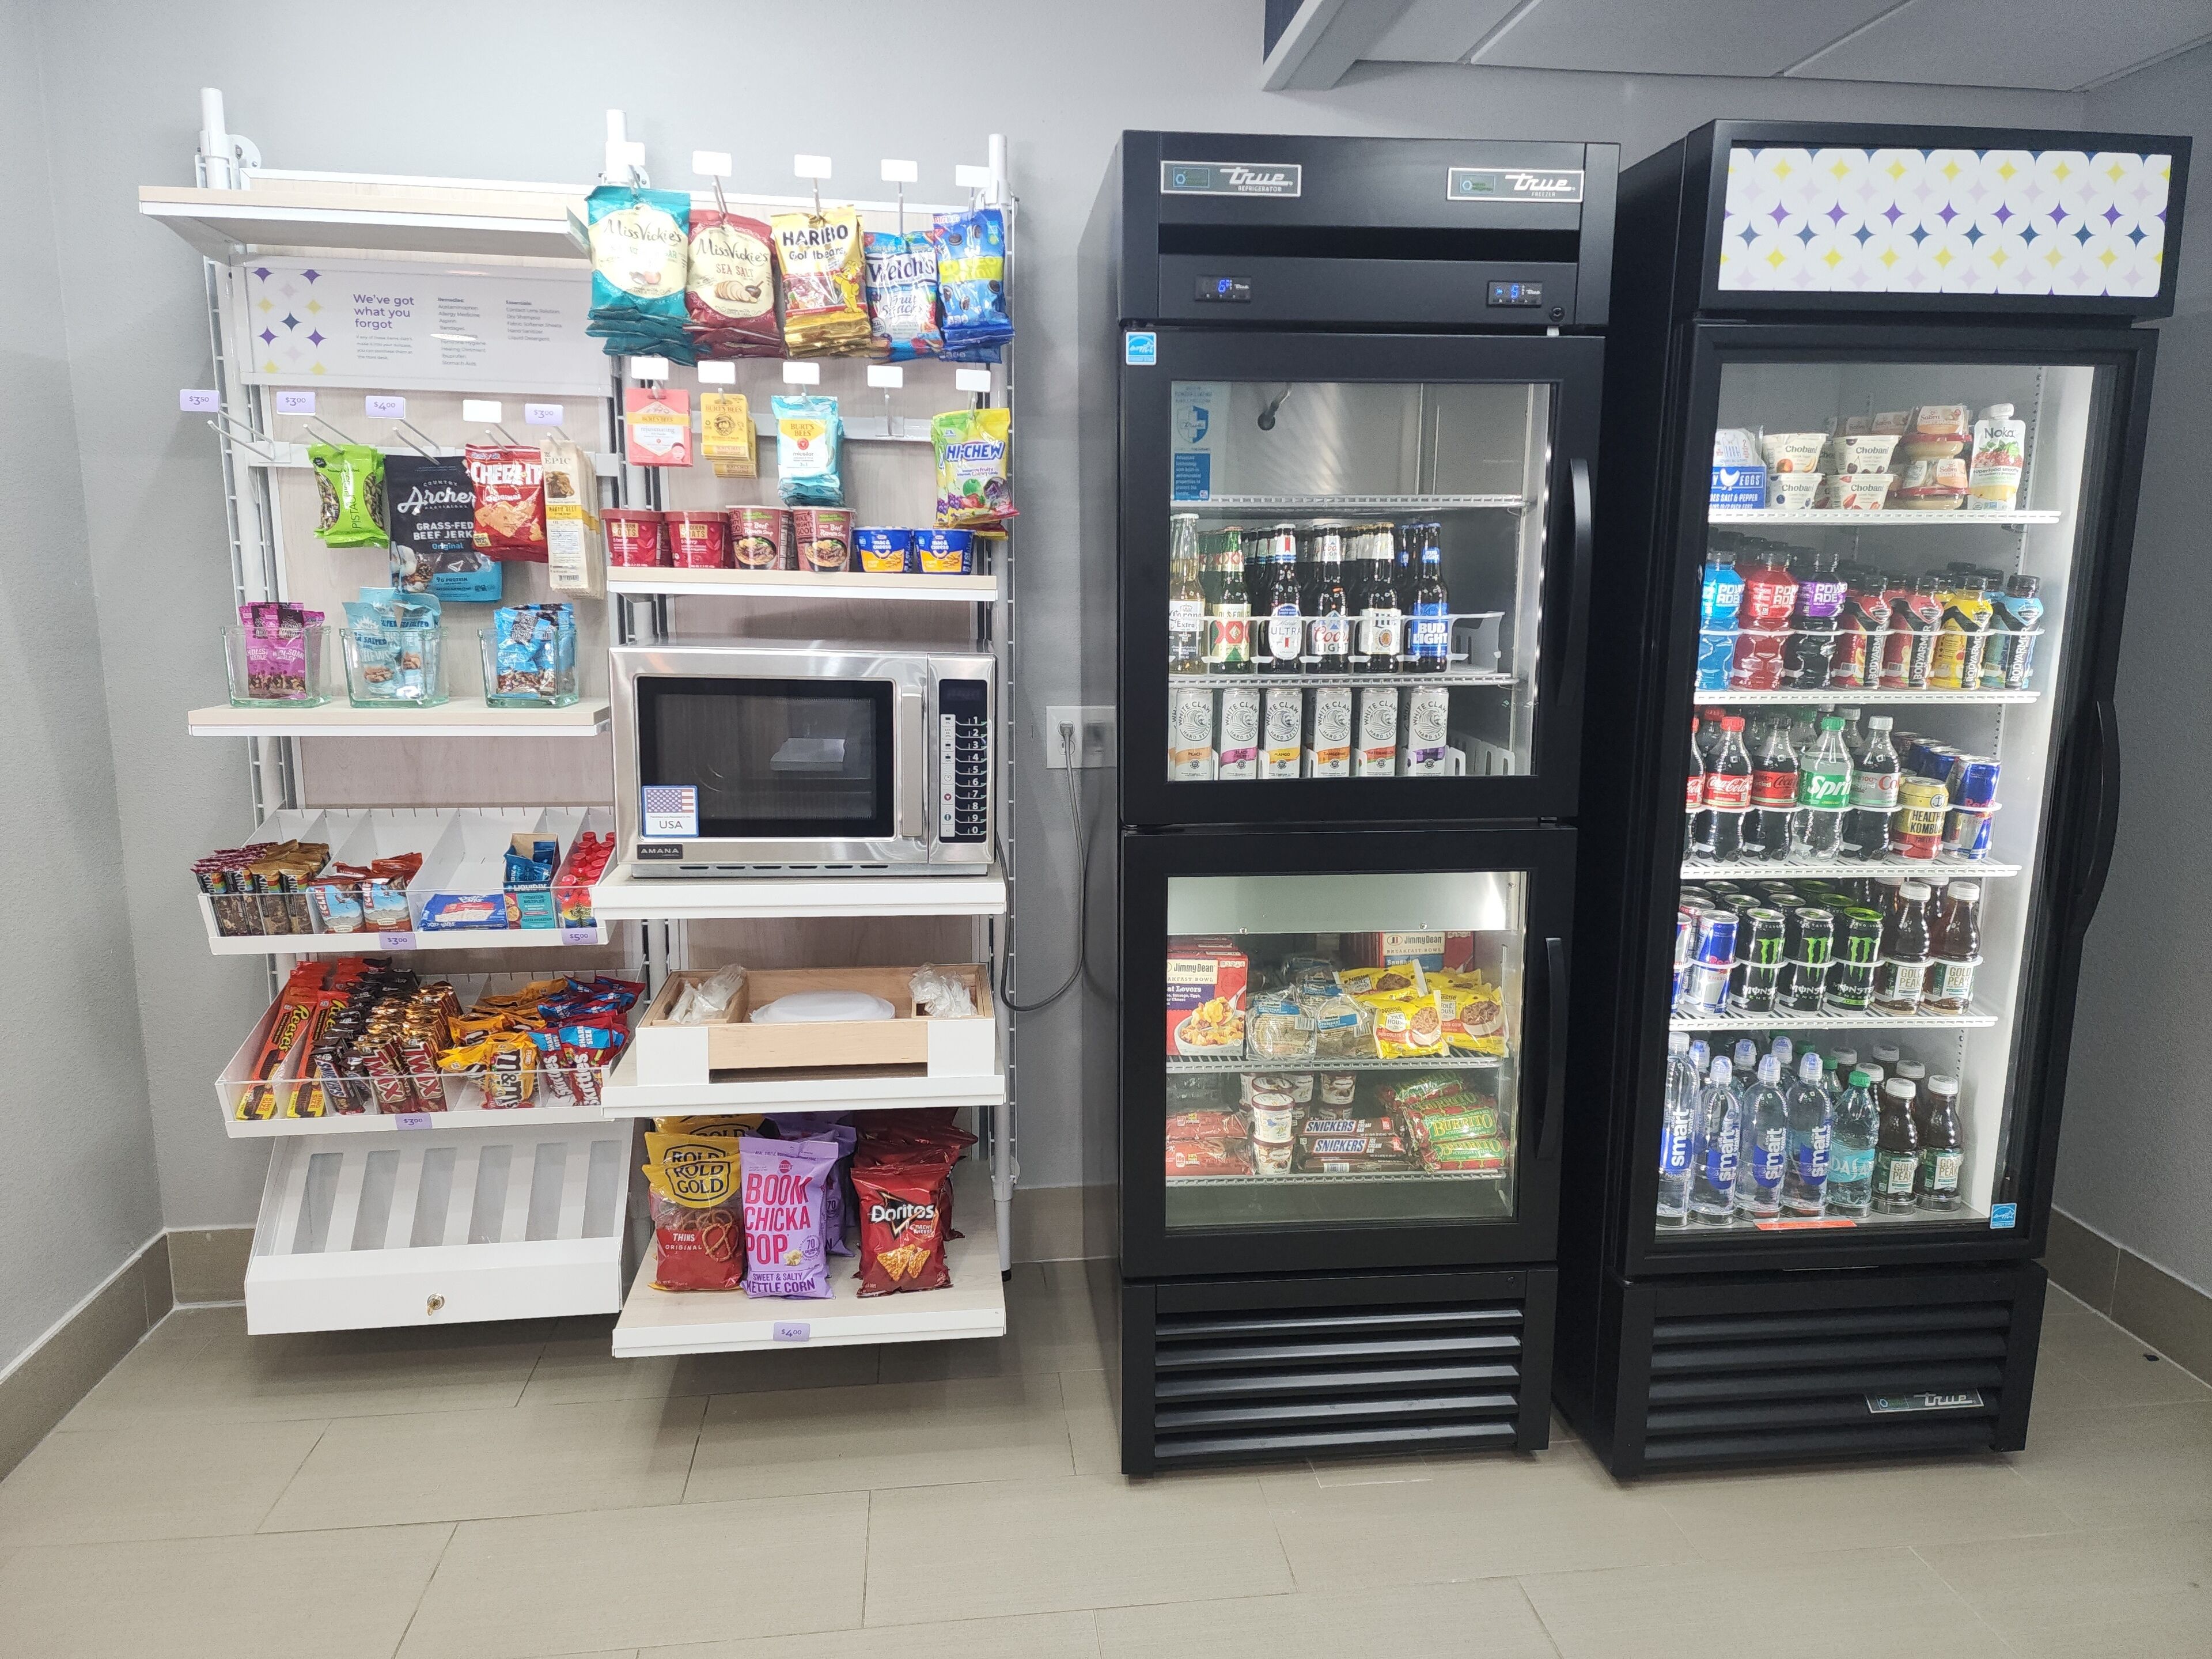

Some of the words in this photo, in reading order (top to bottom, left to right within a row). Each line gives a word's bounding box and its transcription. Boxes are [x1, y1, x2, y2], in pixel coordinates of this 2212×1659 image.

[783, 224, 849, 247] HARIBO
[716, 263, 732, 275] SEA
[736, 266, 754, 278] SALT
[868, 256, 934, 282] Welch's
[353, 294, 391, 304] We've
[394, 297, 415, 306] got
[354, 306, 385, 316] what
[388, 309, 410, 319] you
[355, 319, 393, 330] forgot
[1984, 427, 2014, 438] Noka
[1739, 475, 1761, 486] EGGS
[397, 486, 477, 516] Archer
[416, 522, 474, 531] GRASS-FED
[413, 531, 441, 540] BEEF
[444, 531, 475, 539] JERK
[432, 543, 464, 551] Original
[1716, 595, 1740, 604] ADE
[1774, 595, 1795, 604] ADE
[1814, 594, 1838, 603] ADE
[1176, 620, 1196, 628] Extra
[1419, 623, 1446, 634] BUD
[1271, 627, 1301, 635] ULTRA
[1412, 634, 1448, 645] LIGHT
[1178, 703, 1190, 726] WHITE
[1192, 701, 1211, 714] CLAW
[1225, 703, 1238, 726] WHITE
[1240, 701, 1257, 714] CLAW
[1267, 703, 1278, 726] WHITE
[1279, 702, 1299, 714] CLAW
[1318, 703, 1331, 726] WHITE
[1332, 701, 1350, 713] CLAW
[1364, 702, 1377, 725] WHITE
[1378, 700, 1396, 712] CLAW
[1413, 703, 1427, 726] WHITE
[1428, 701, 1446, 713] CLAW
[974, 716, 978, 724] 1
[972, 728, 979, 736] 2
[1183, 730, 1196, 740] HARD
[1230, 730, 1244, 740] HARD
[1271, 730, 1283, 740] HARD
[1323, 730, 1337, 739] HARD
[1369, 729, 1384, 738] HARD
[1418, 730, 1432, 740] HARD
[972, 778, 979, 786] 6
[1808, 776, 1852, 799] Spri
[972, 802, 979, 810] 8
[972, 814, 979, 822] 9
[660, 821, 683, 829] USA
[234, 870, 247, 892] KIND
[1404, 935, 1425, 945] Jimmy
[1426, 935, 1442, 944] Dean
[1174, 963, 1196, 973] Jimmy
[1197, 963, 1214, 972] Dean
[1949, 967, 1971, 977] GOLD
[1900, 978, 1921, 987] PEAK
[278, 1005, 310, 1054] Reese's
[577, 1025, 586, 1048] SHARE
[363, 1049, 405, 1101] TWIX
[405, 1041, 442, 1098] TWIX
[317, 1060, 346, 1098] SNICKERS
[575, 1054, 601, 1107] Skittles
[1306, 1121, 1354, 1131] SNICKERS
[1432, 1113, 1493, 1137] BURRITO
[1687, 1109, 1695, 1135] water
[1671, 1109, 1689, 1167] smart
[1315, 1140, 1365, 1152] SNICKERS
[1439, 1139, 1501, 1156] BURRITO
[1719, 1129, 1734, 1181] smart
[1765, 1128, 1783, 1181] smart
[1812, 1126, 1827, 1178] smart
[674, 1165, 724, 1179] ROLD
[1830, 1156, 1872, 1180] DASA
[1939, 1168, 1958, 1176] PEAK
[1893, 1172, 1912, 1180] PEAK
[677, 1179, 724, 1194] GOLD
[745, 1173, 813, 1206] BOOM
[828, 1200, 836, 1210] 70
[744, 1206, 812, 1232] CHICKA
[871, 1205, 934, 1222] Doritos
[673, 1233, 695, 1242] THINS
[806, 1238, 815, 1248] 70
[746, 1233, 788, 1265] POP
[753, 1273, 774, 1281] SWEET
[776, 1273, 782, 1281] &
[783, 1272, 802, 1281] SALTY
[747, 1281, 782, 1293] KETTLE
[784, 1278, 815, 1293] CORN
